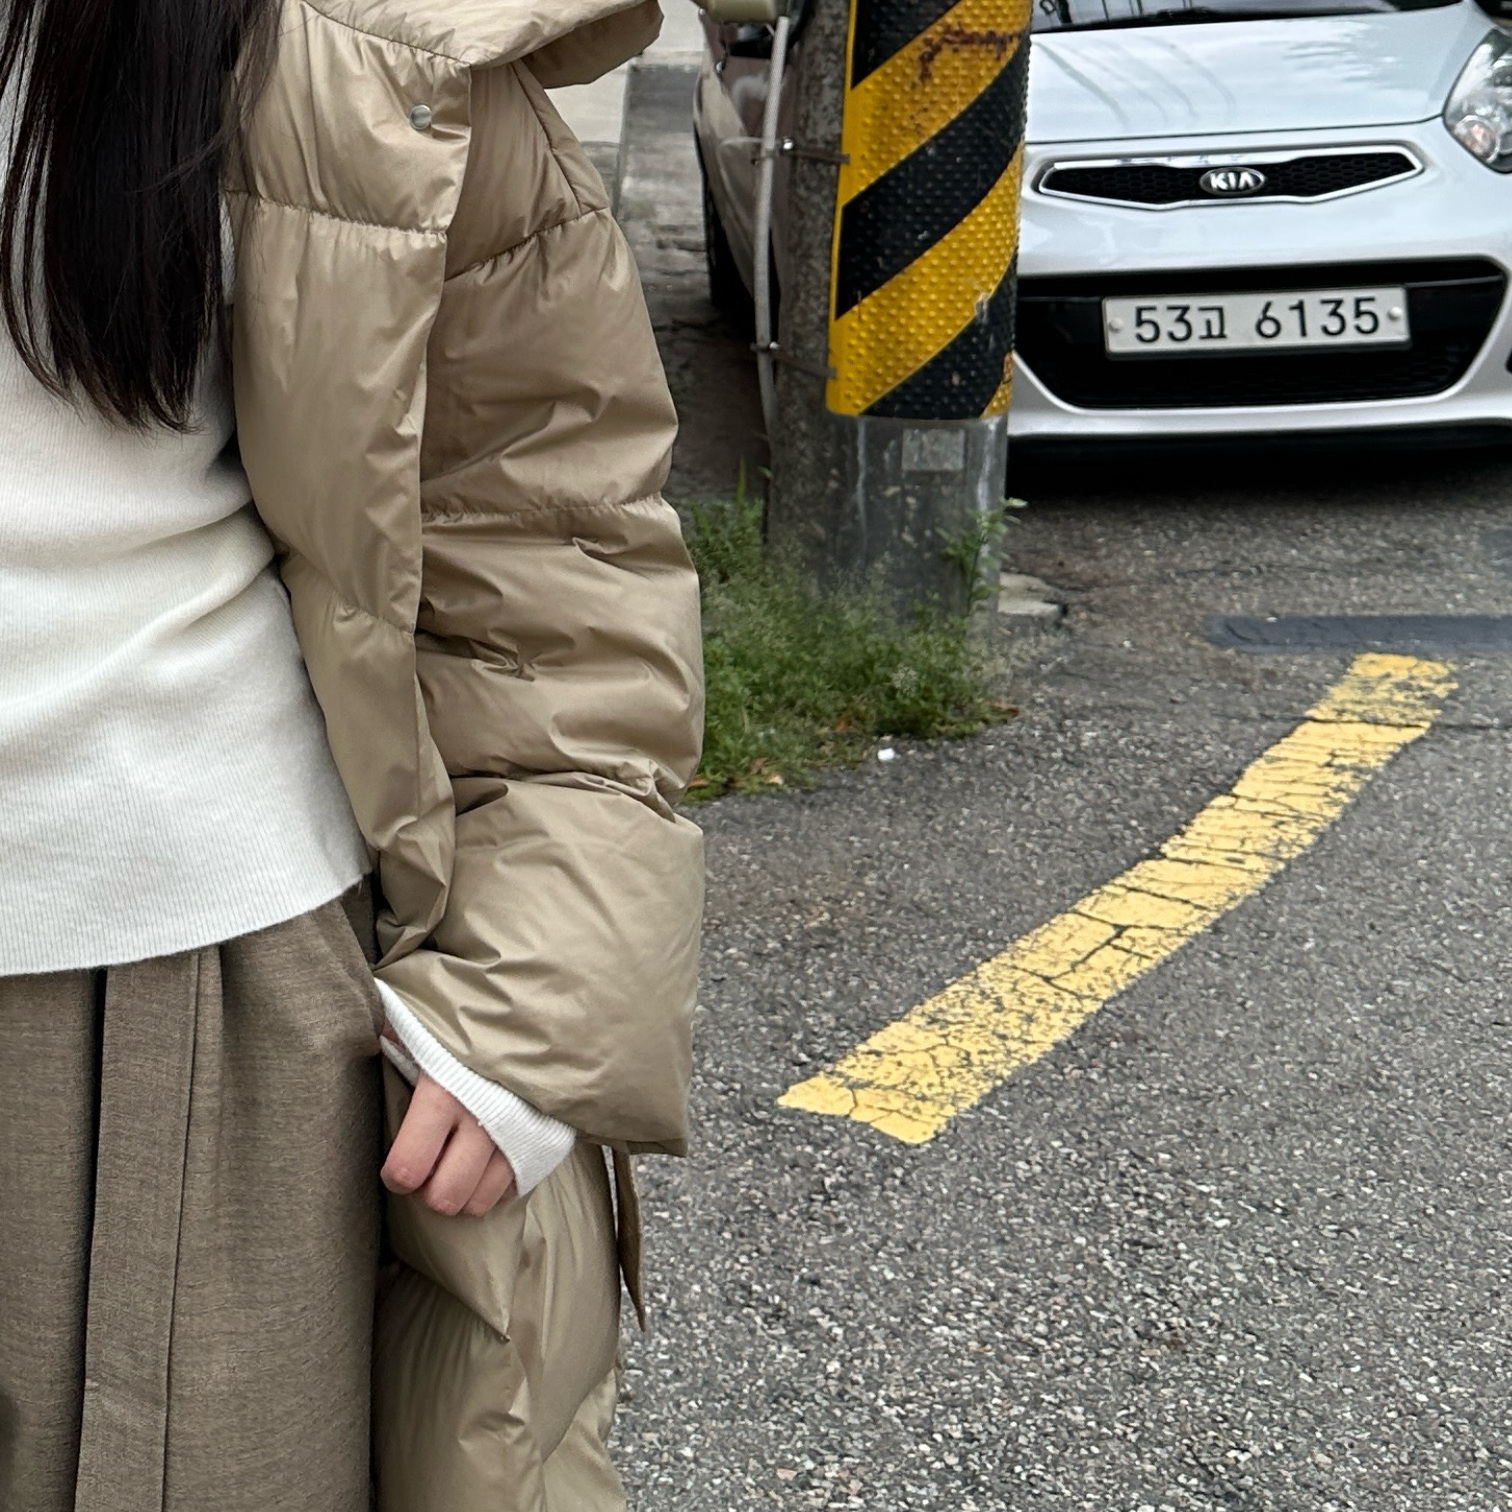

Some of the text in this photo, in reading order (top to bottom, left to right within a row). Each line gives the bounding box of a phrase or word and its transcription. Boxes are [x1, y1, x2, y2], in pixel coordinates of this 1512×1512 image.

[1209, 170, 1254, 191] KIA
[1135, 297, 1380, 344] 53고 6135
